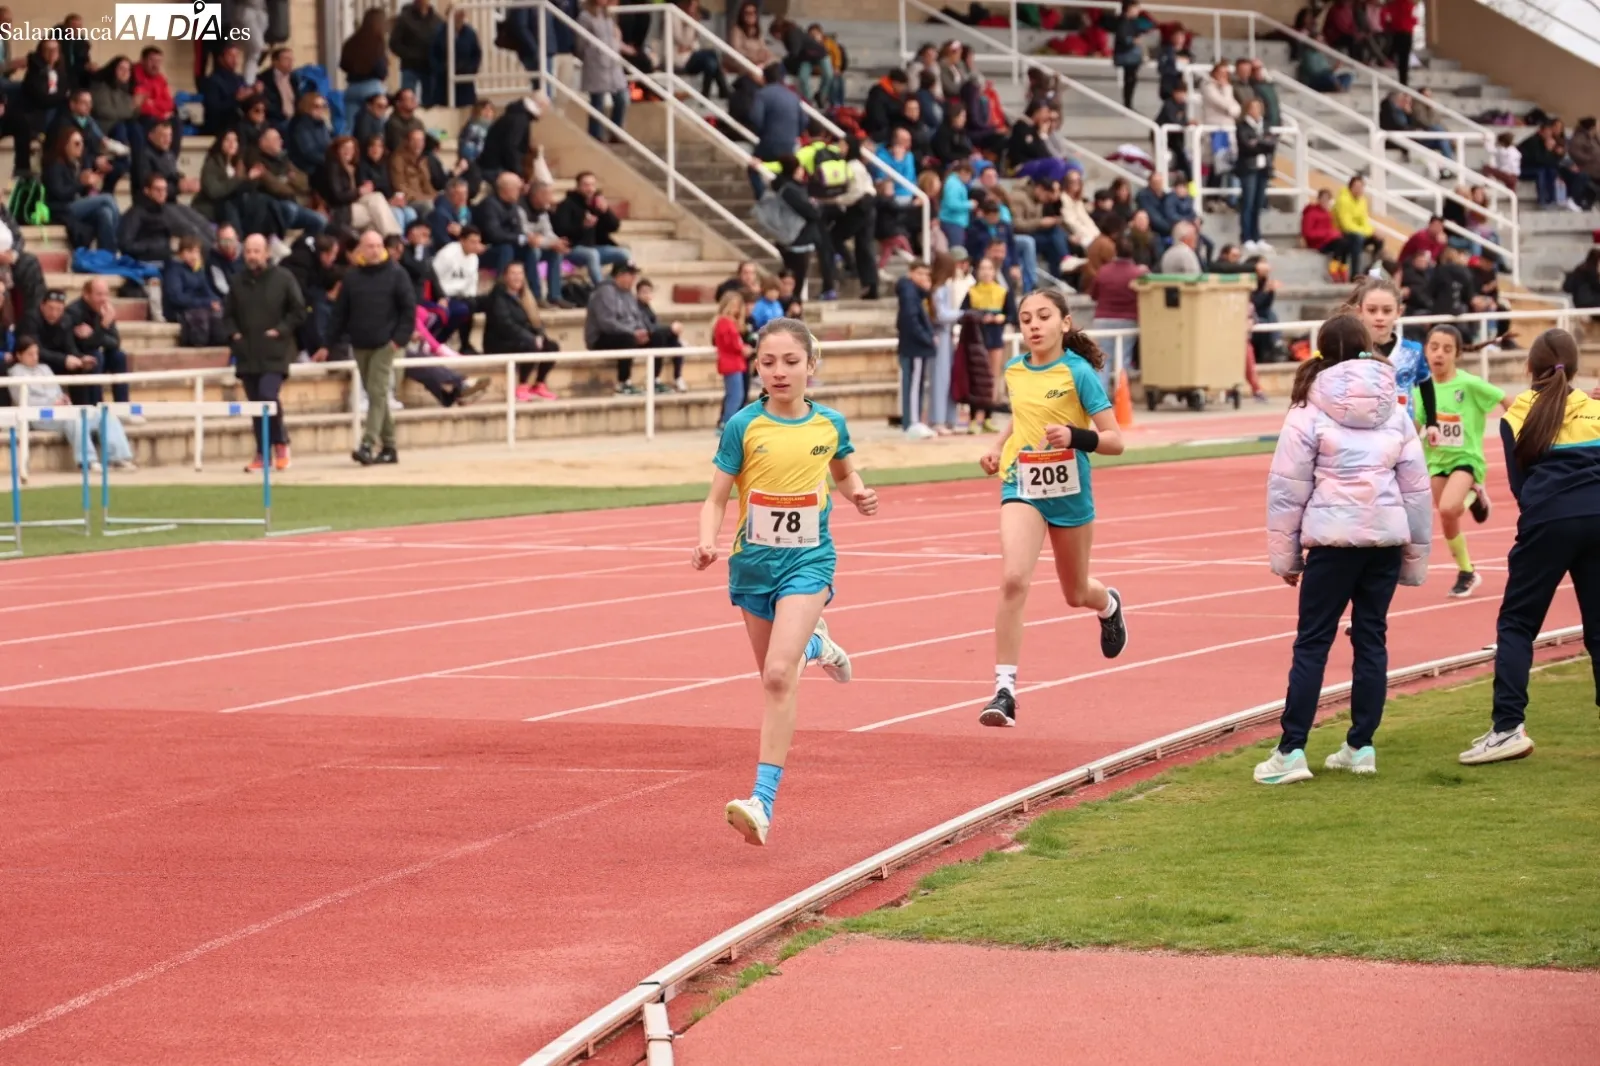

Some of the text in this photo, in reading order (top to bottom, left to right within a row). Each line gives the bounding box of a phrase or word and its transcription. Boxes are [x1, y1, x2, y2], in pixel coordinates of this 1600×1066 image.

[1437, 423, 1461, 437] 80
[1029, 464, 1069, 486] 208
[770, 511, 801, 533] 78
